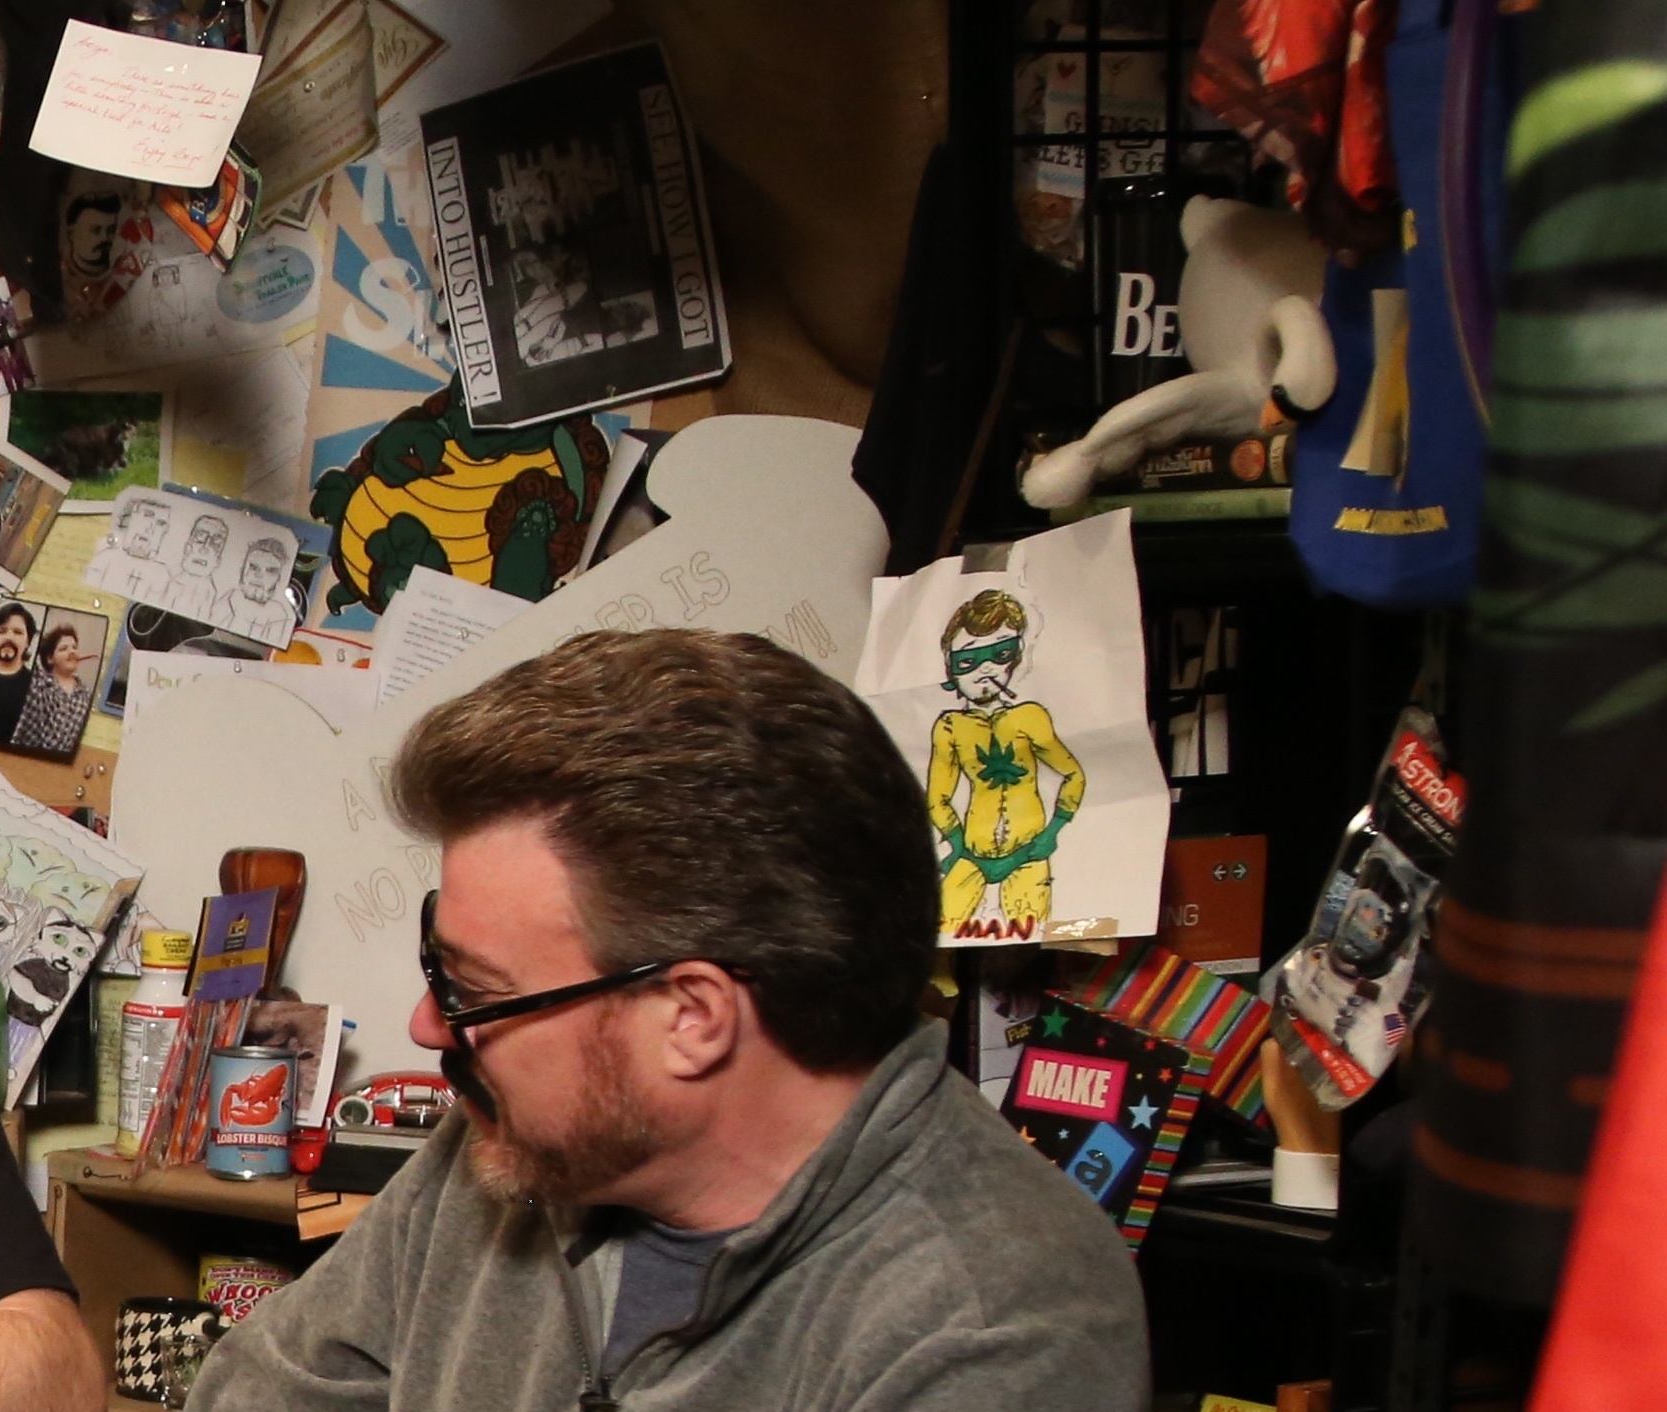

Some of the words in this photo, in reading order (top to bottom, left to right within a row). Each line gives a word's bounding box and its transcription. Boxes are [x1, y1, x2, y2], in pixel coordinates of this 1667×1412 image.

[430, 143, 467, 224] INTO
[445, 233, 493, 383] HUSTLER
[676, 271, 710, 344] GOT
[1111, 272, 1184, 357] BE
[953, 914, 1037, 942] MAN
[1026, 1059, 1113, 1109] MAKE
[217, 1130, 257, 1145] LOBSTER
[258, 1131, 290, 1147] BISQUE
[1073, 1148, 1114, 1196] a
